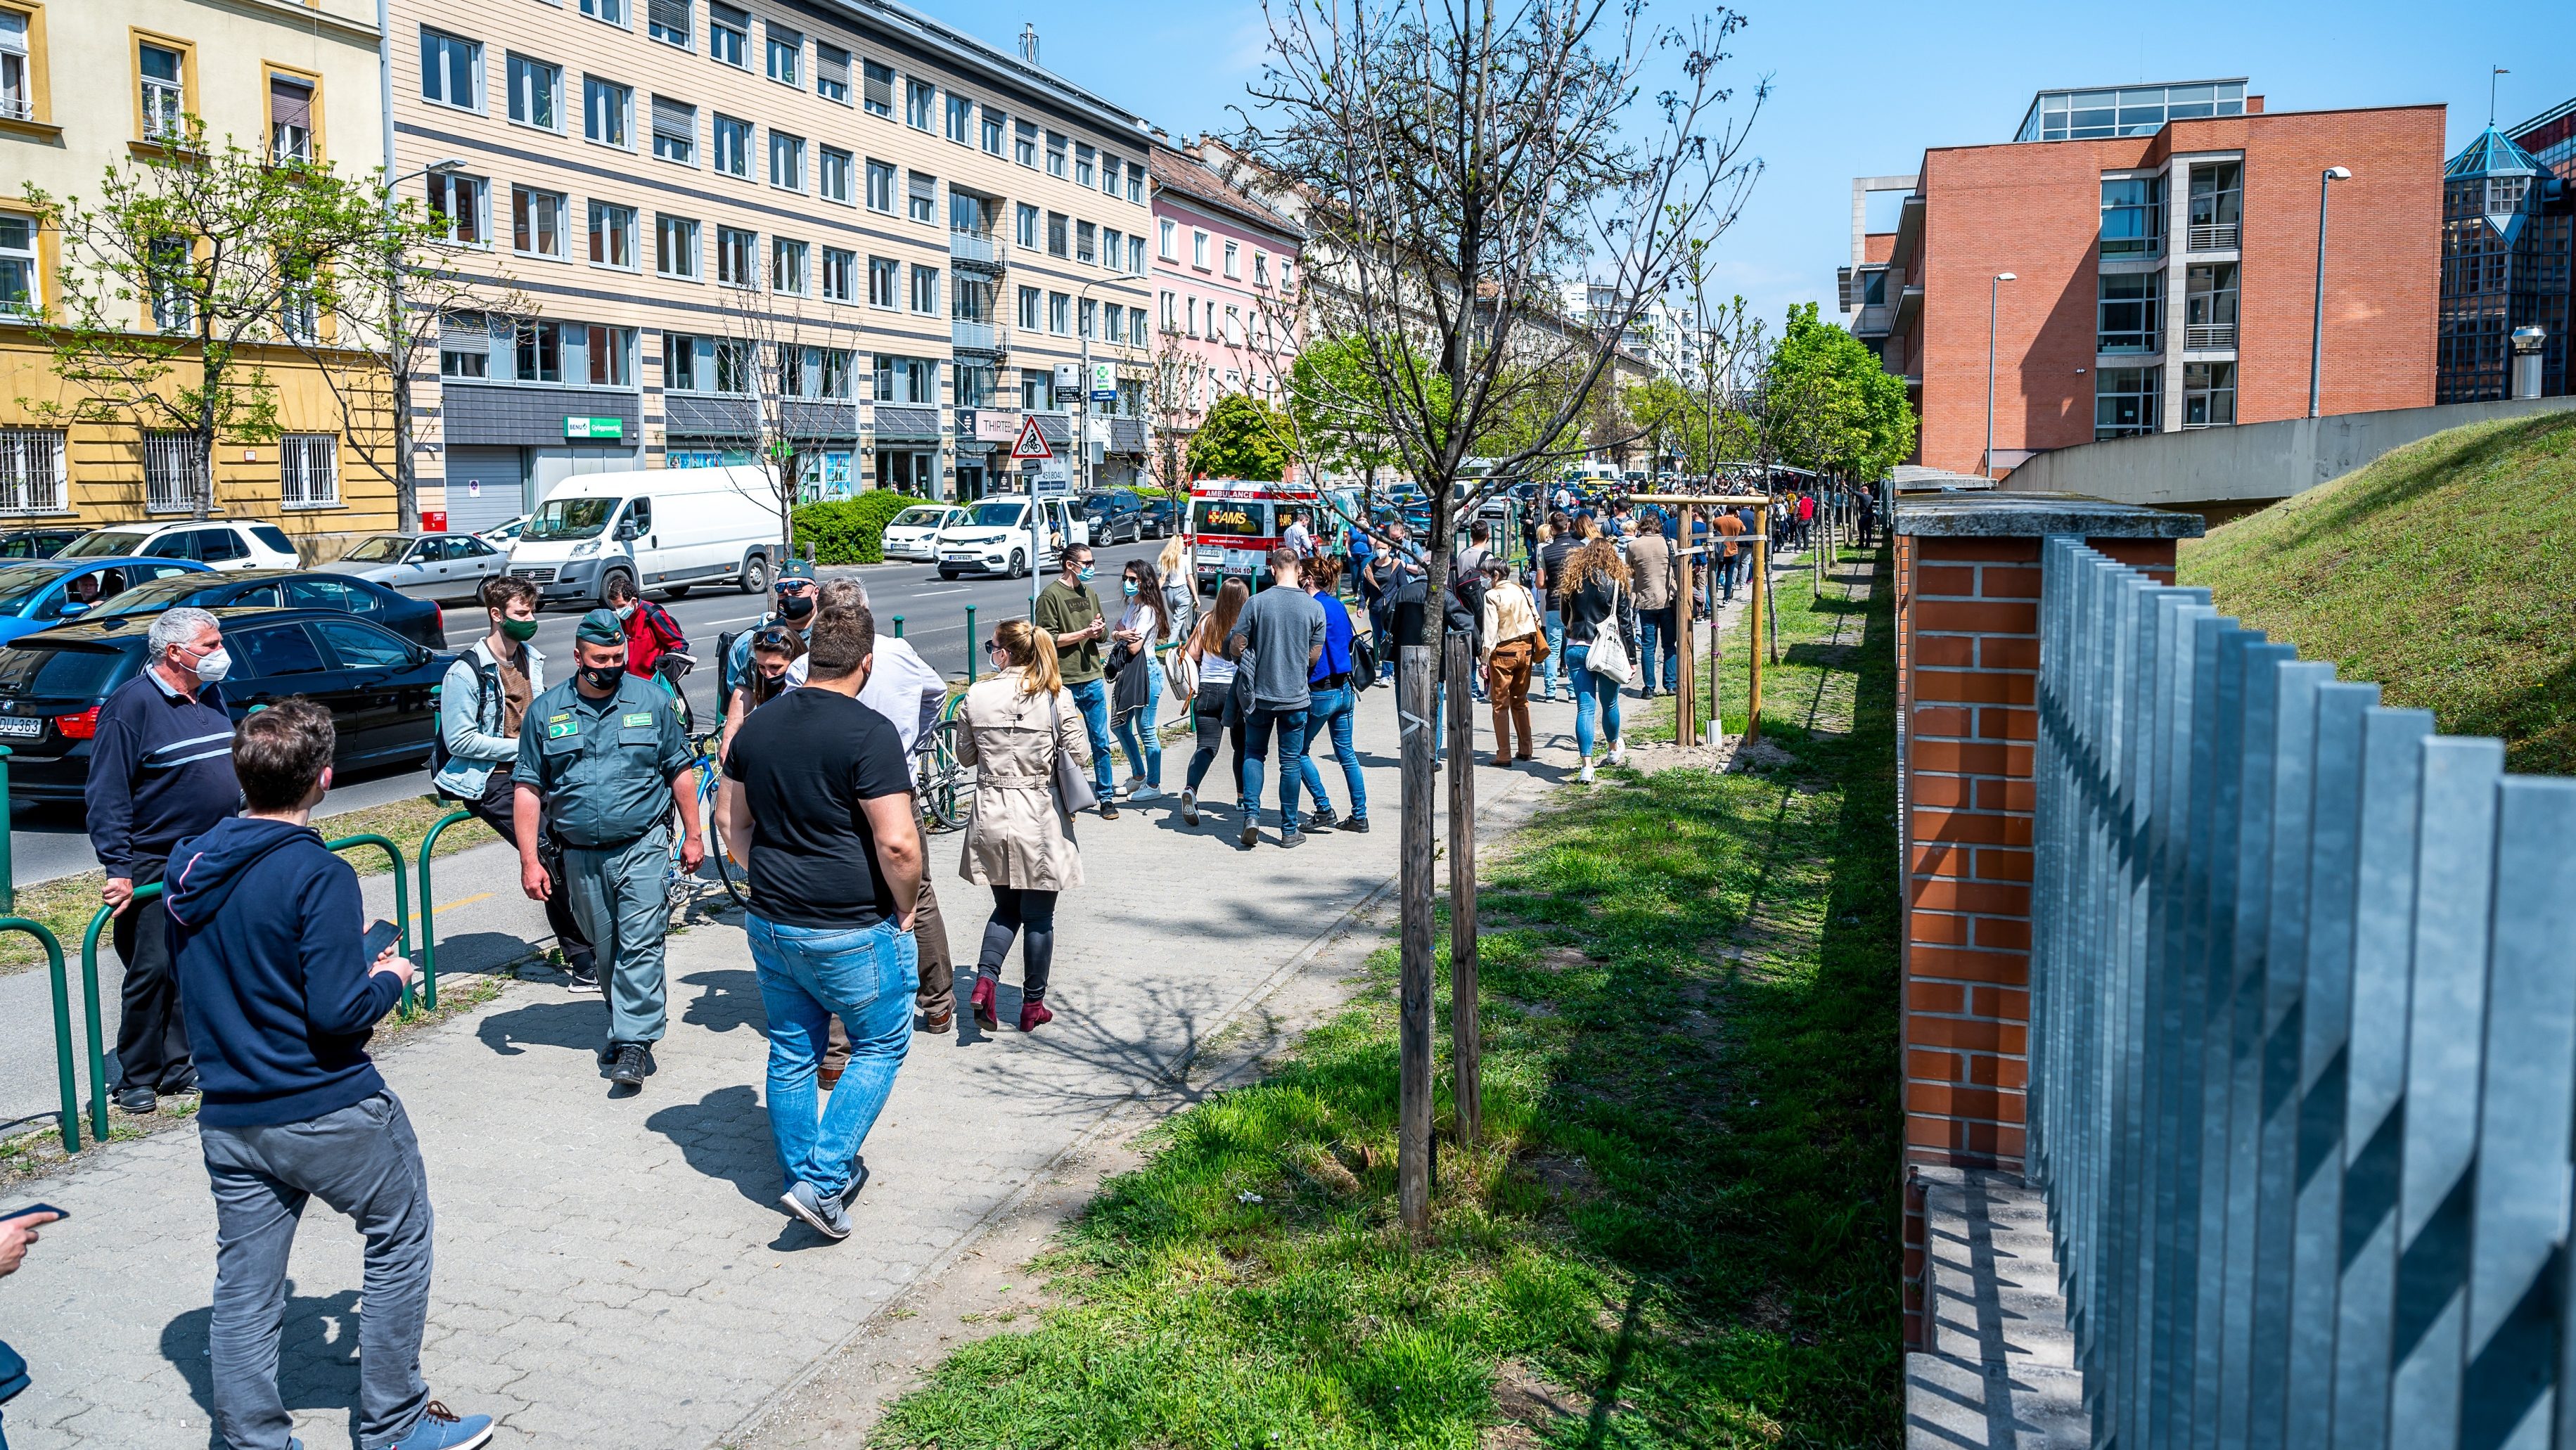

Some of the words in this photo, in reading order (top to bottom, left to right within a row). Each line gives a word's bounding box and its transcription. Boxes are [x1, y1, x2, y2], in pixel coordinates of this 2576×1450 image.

[983, 420, 1013, 432] THIRTEEN
[1205, 490, 1254, 499] AMBULANCE
[1219, 511, 1246, 525] AMS
[1283, 514, 1292, 526] AMS
